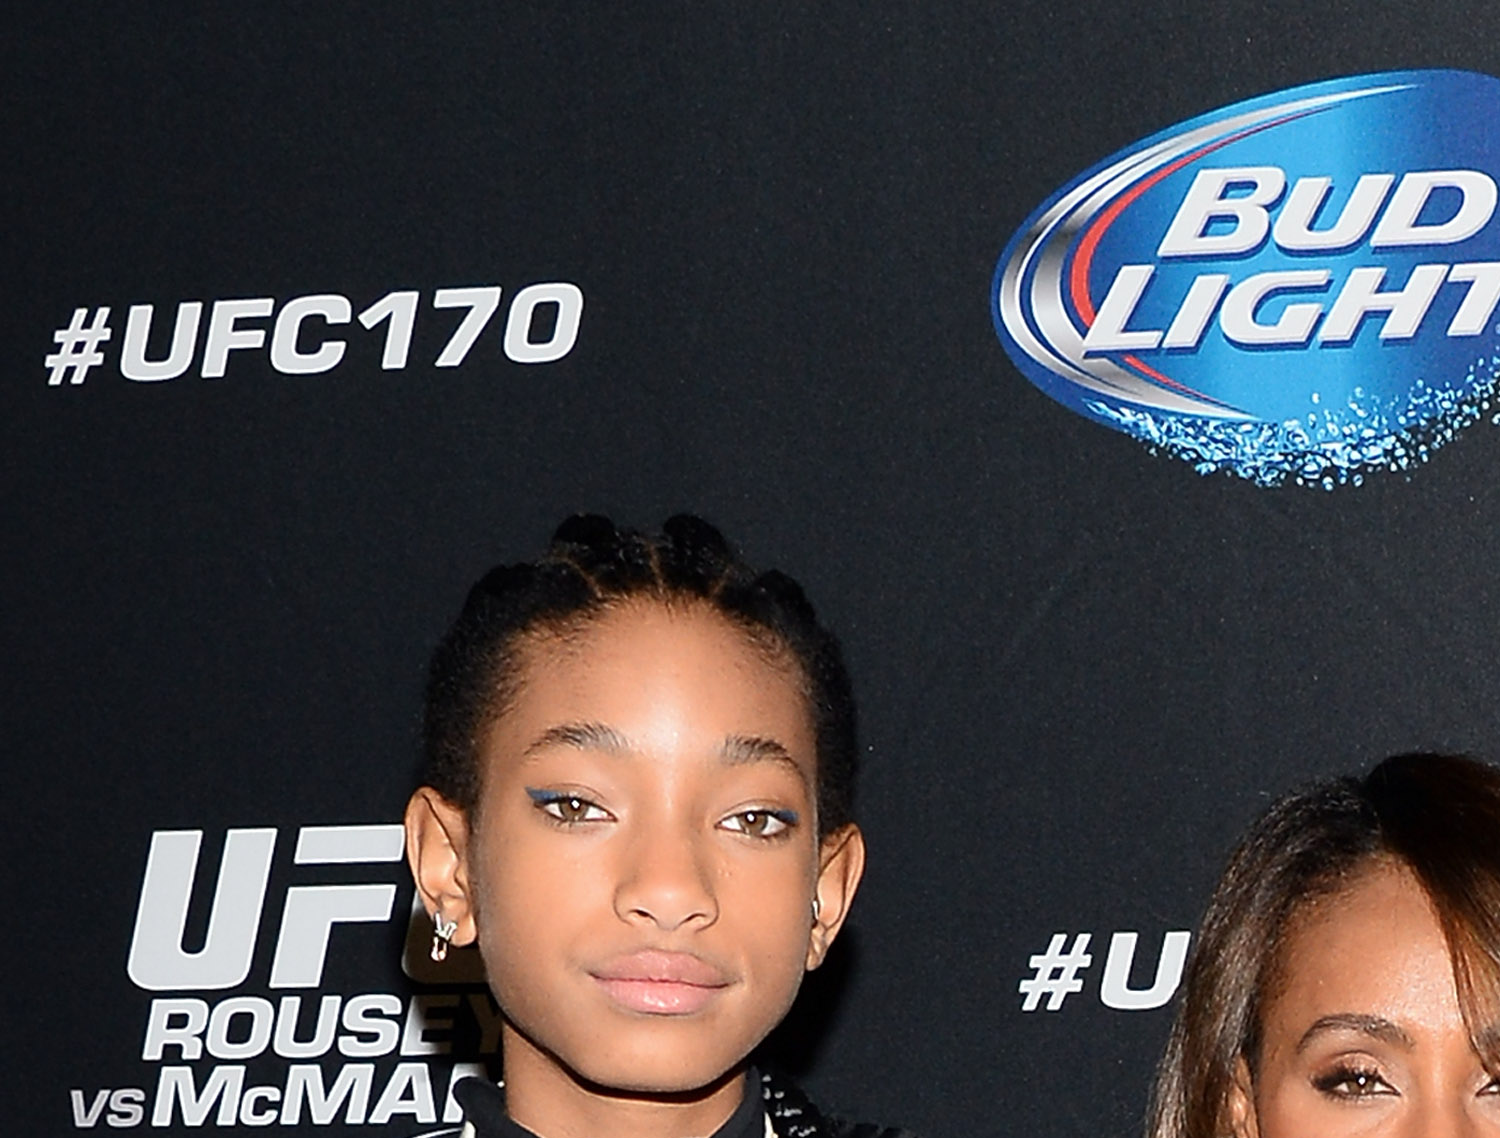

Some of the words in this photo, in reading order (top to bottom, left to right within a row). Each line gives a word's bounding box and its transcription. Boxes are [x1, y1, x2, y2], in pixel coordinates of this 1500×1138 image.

[1157, 166, 1500, 259] BUD
[45, 283, 584, 386] #UFC170
[70, 1088, 146, 1128] VS
